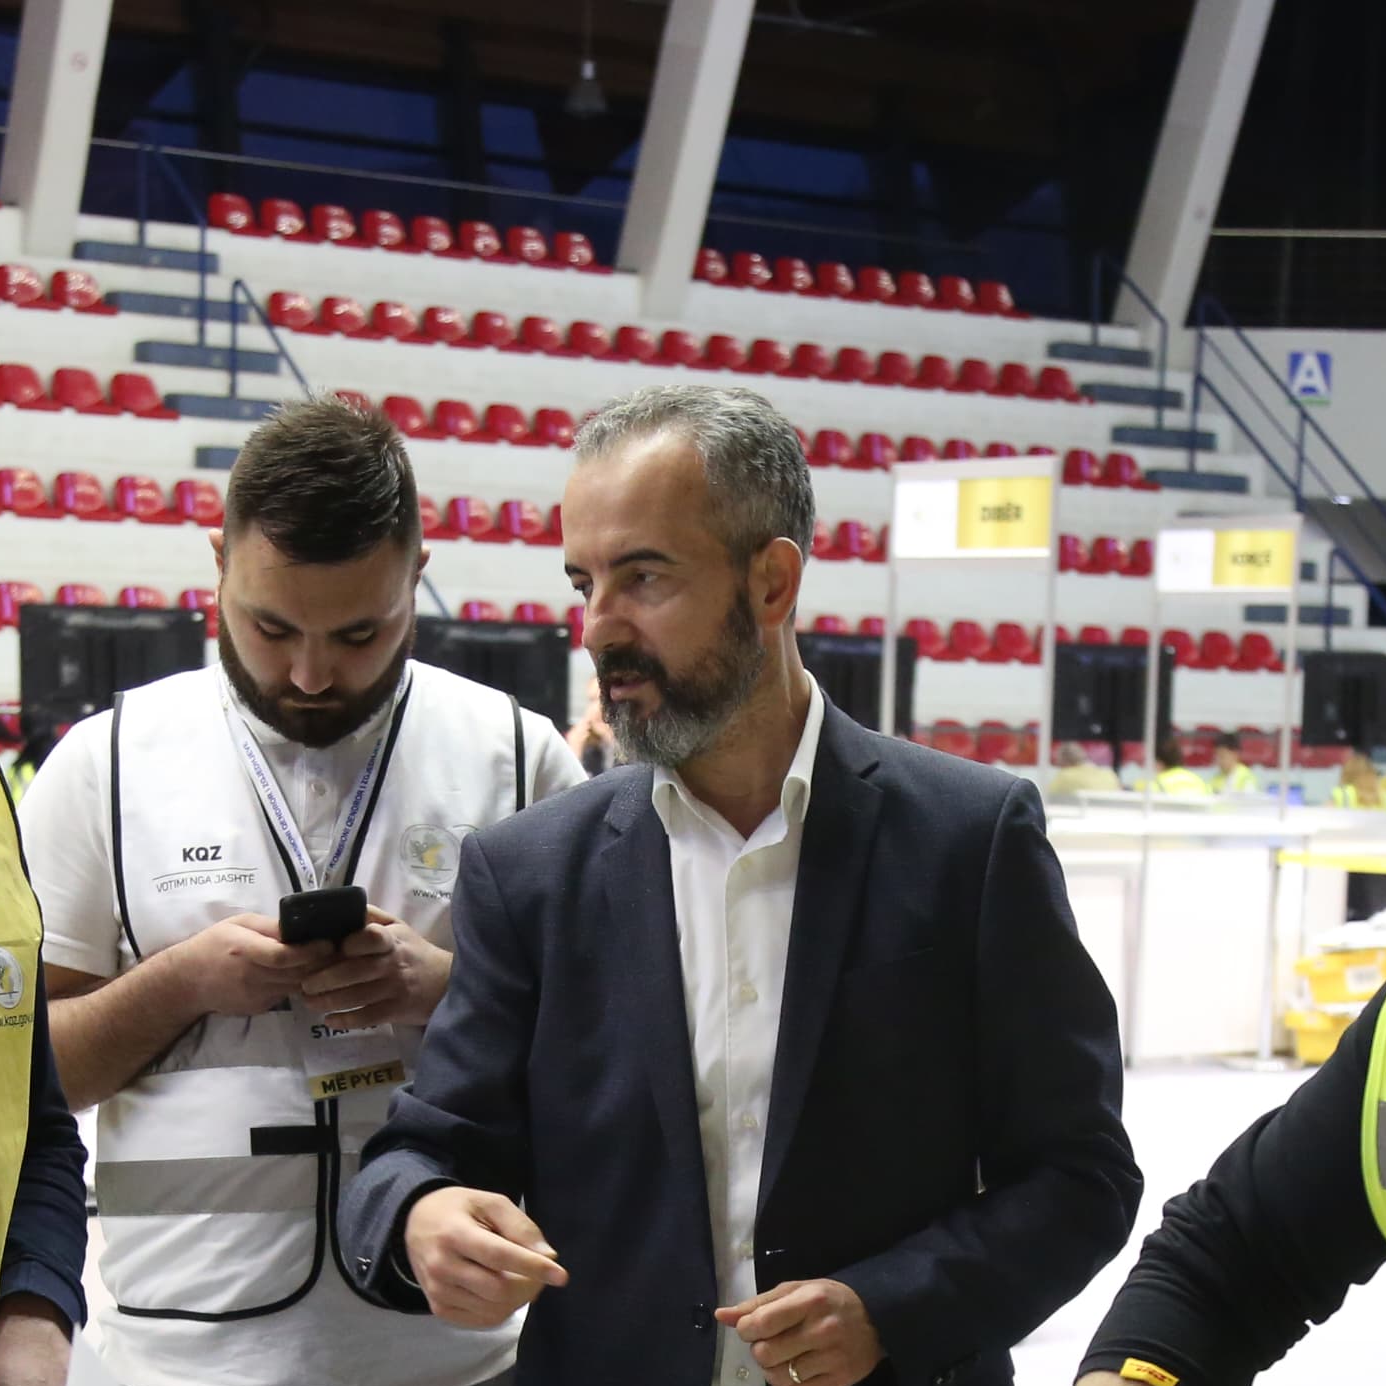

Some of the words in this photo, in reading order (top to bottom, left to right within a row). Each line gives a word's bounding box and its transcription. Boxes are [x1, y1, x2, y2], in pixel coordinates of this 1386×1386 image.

[182, 845, 222, 862] KQZ
[156, 879, 189, 893] VOTIMI
[189, 875, 212, 886] NGA
[349, 1066, 394, 1090] PYET
